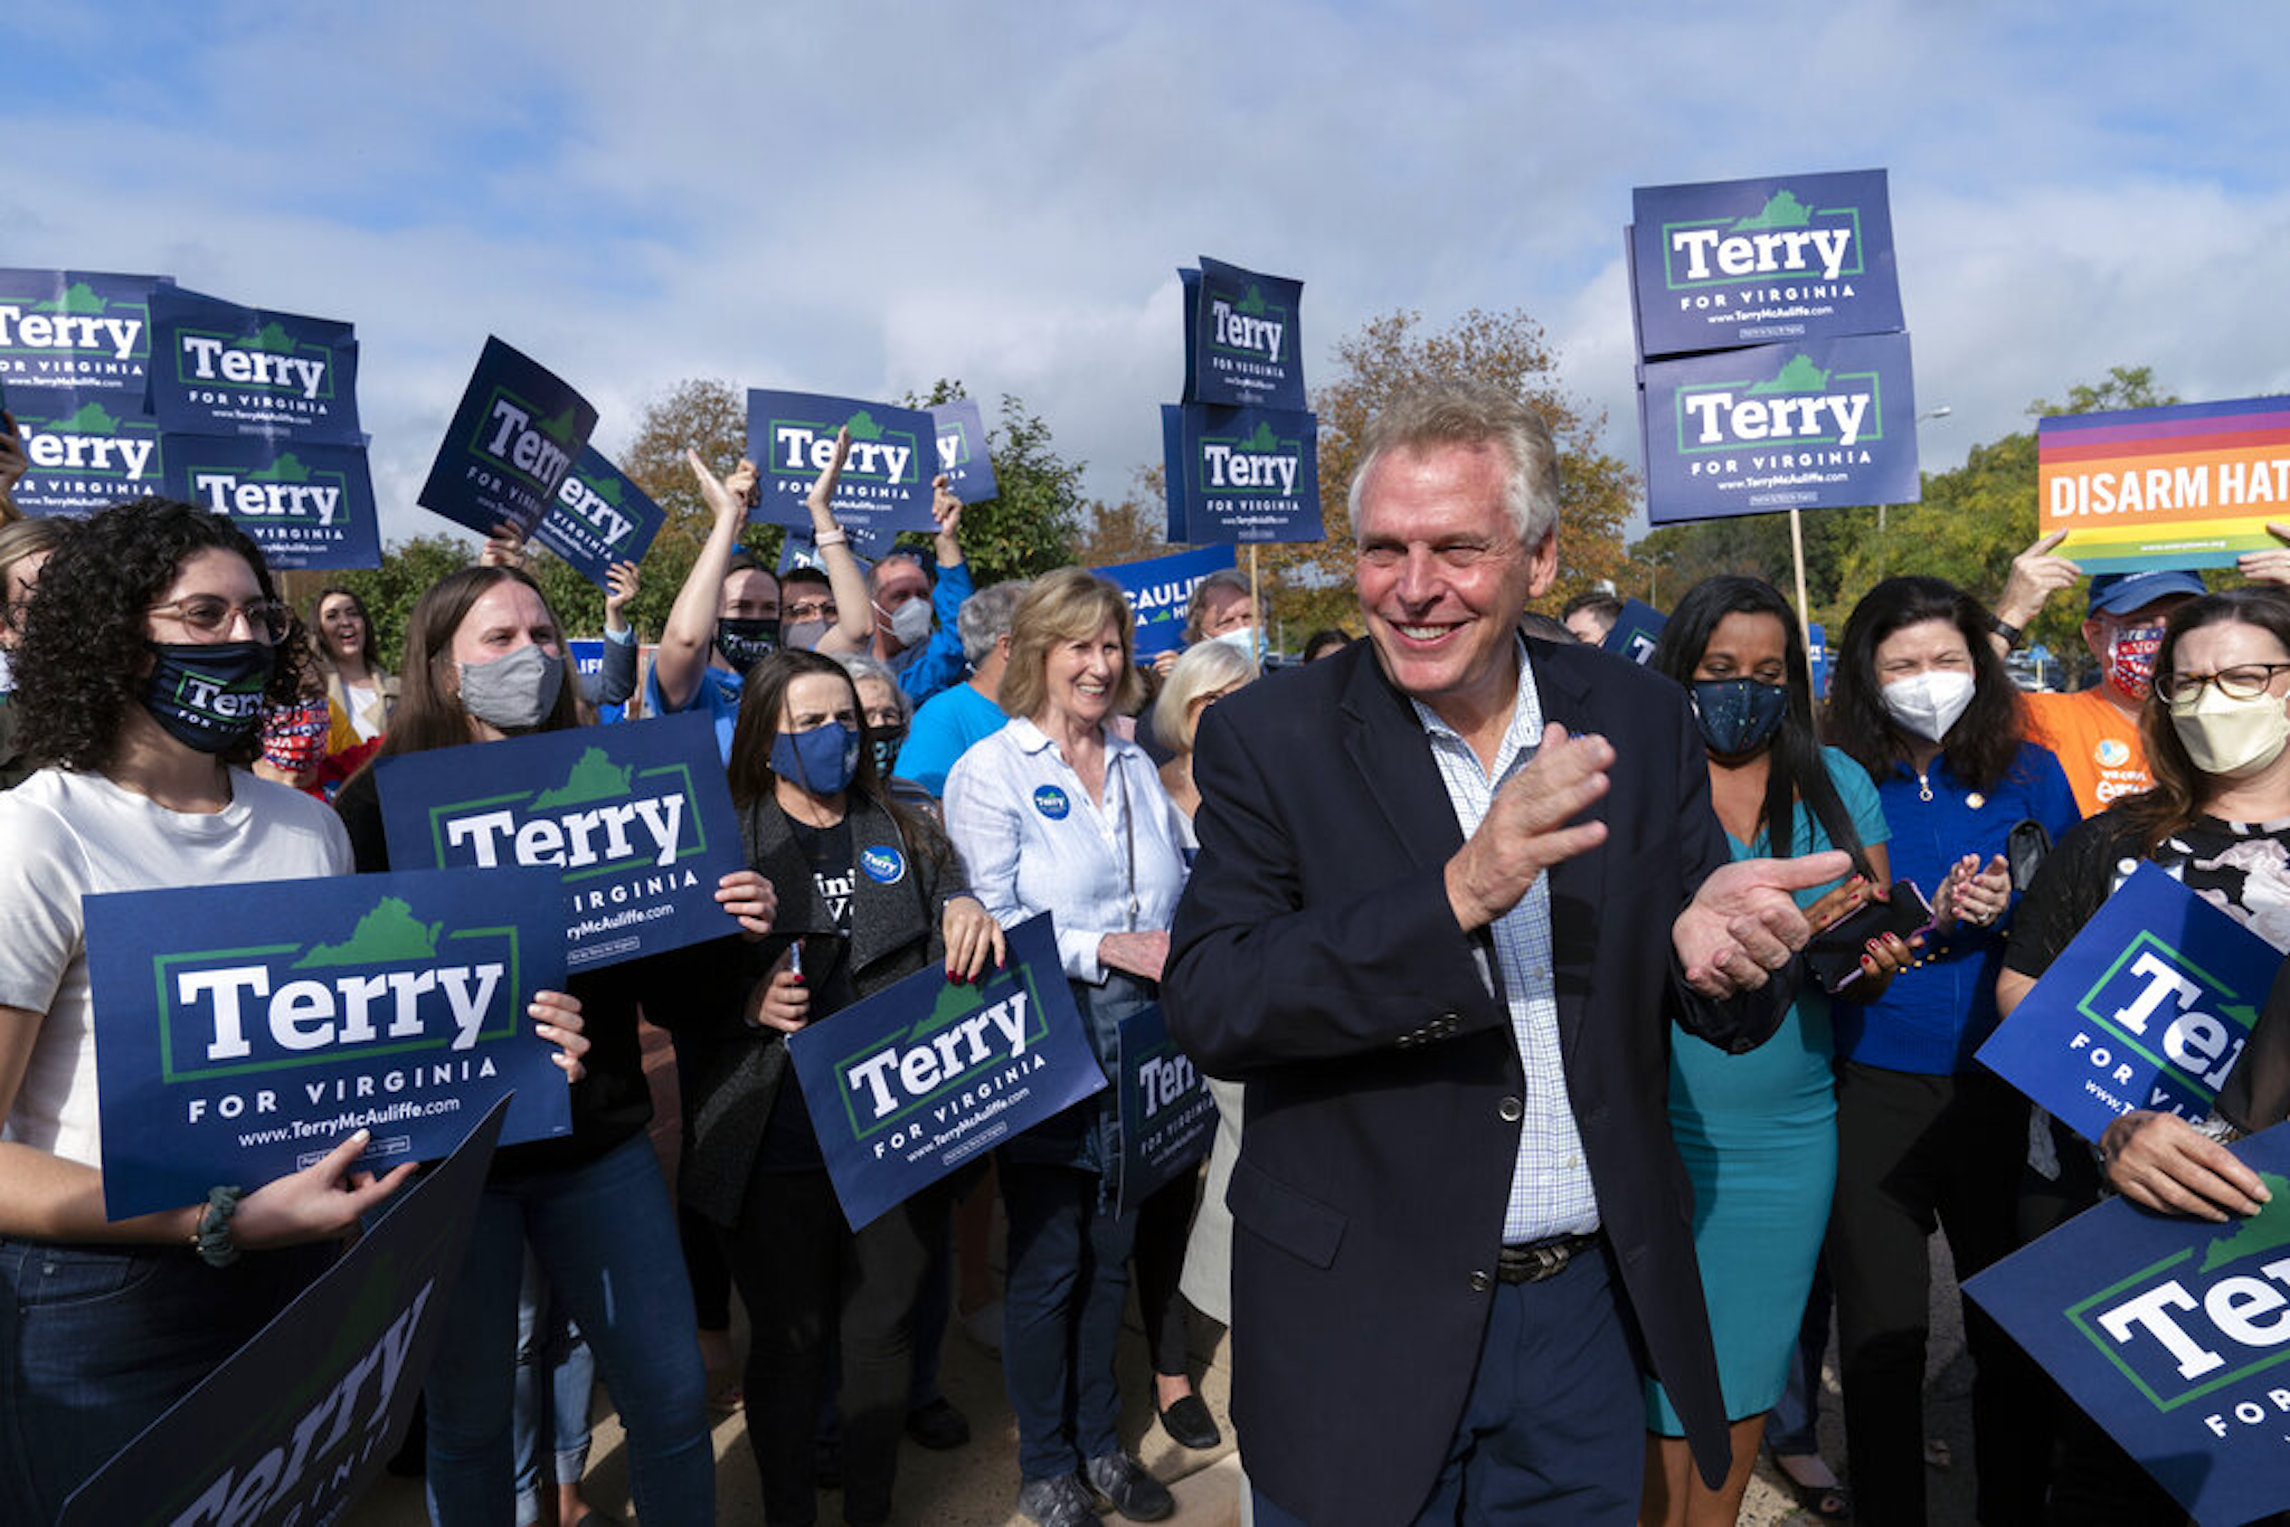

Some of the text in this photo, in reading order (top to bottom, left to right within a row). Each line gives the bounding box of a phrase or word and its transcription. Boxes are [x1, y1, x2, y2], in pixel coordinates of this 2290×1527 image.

[1673, 229, 1851, 281] Terry
[1681, 285, 1855, 311] FOR VIRGINIA
[1212, 300, 1283, 363] Terry
[39, 360, 143, 377] VIRGINIA
[183, 336, 325, 400] Terry
[189, 390, 328, 415] FOR VIRGINIA
[1685, 393, 1871, 446] Terry
[48, 481, 154, 496] VIRGINIA
[466, 465, 502, 492] FOR
[1204, 445, 1298, 497] Terry
[1691, 450, 1872, 476] FOR VIRGINIA
[2050, 459, 2290, 518] DISARM HAT
[196, 474, 340, 526] Terry
[558, 476, 634, 545] erry
[1206, 499, 1300, 511] FOR VIRGINIA
[254, 528, 344, 541] VIRGINIA
[552, 510, 613, 561] VIRGINIA
[446, 793, 684, 868] Terry
[574, 869, 699, 913] IRGINIA
[177, 962, 505, 1061] Terry
[846, 989, 1028, 1119] Terry
[2069, 1031, 2134, 1085] FOR
[188, 1055, 498, 1125] FOR VIRGINIA
[873, 1123, 923, 1160] FOR
[933, 1053, 1046, 1124] VIRGINIA
[238, 1096, 461, 1148] www.TerryMcAuliffe.com
[2097, 1257, 2290, 1381] Te
[2203, 1388, 2290, 1438] FOR
